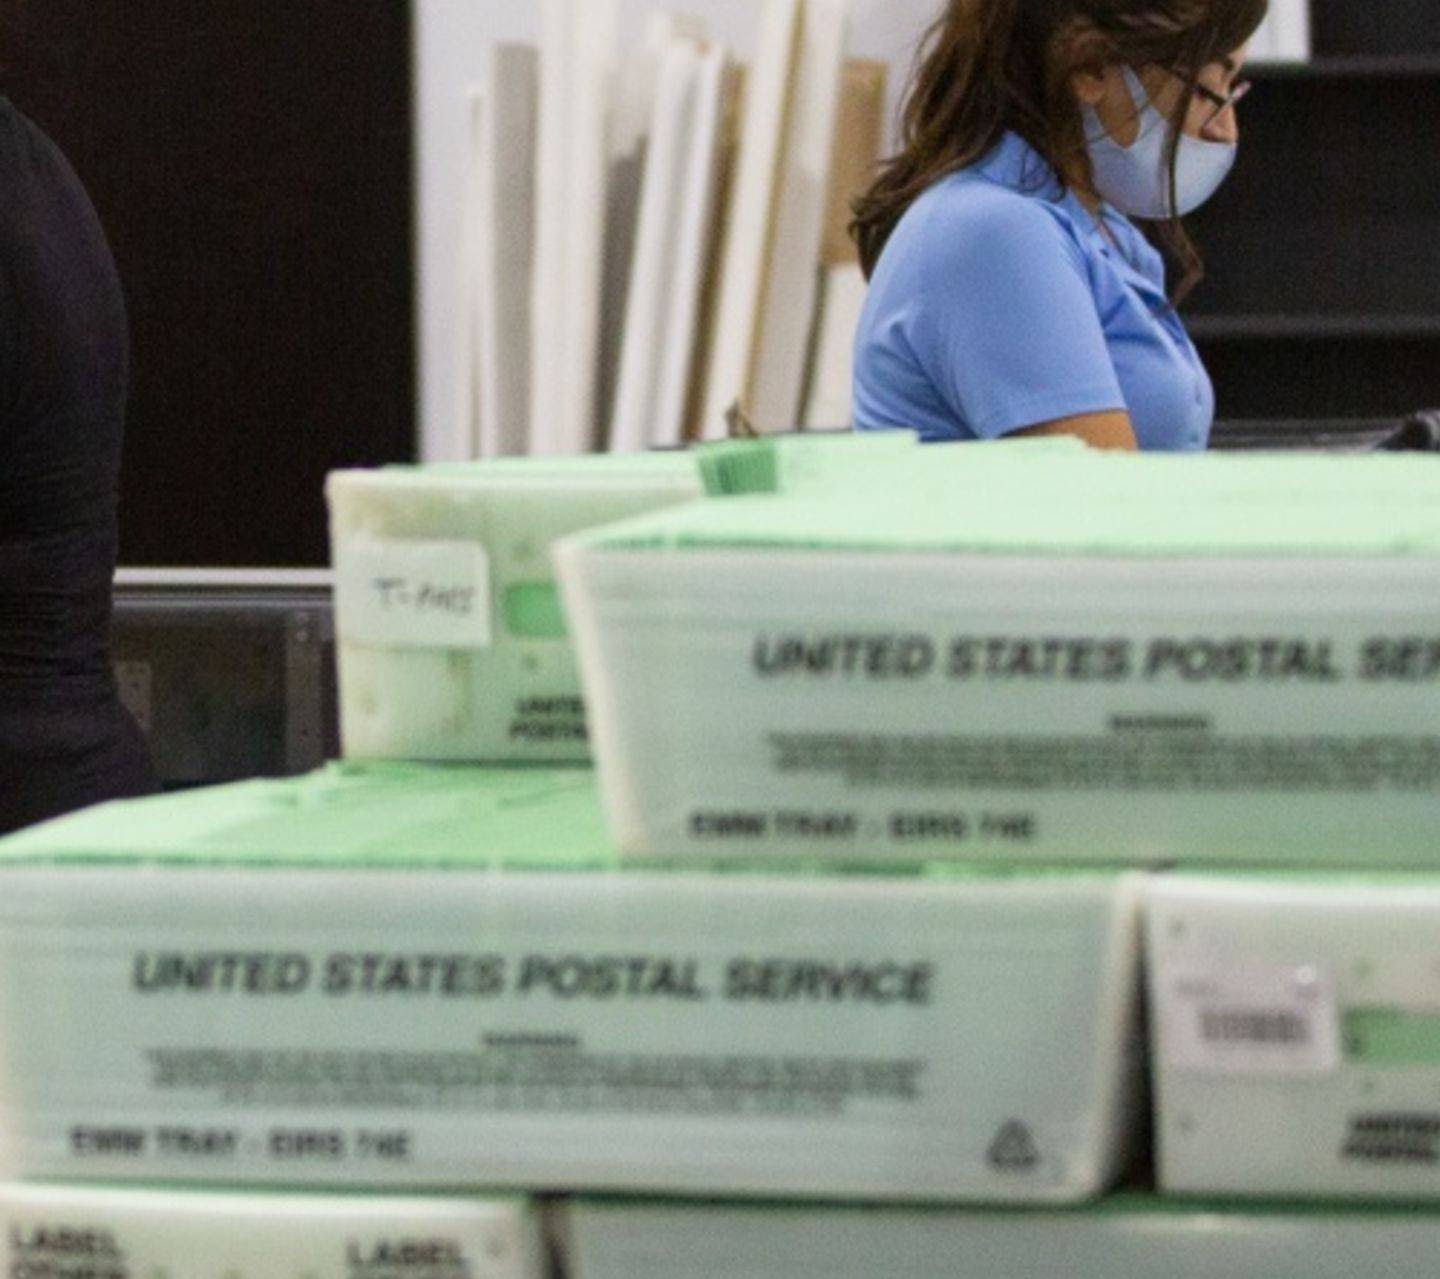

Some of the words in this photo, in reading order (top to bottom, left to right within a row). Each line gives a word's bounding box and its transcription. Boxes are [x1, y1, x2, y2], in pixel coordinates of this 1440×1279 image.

[754, 635, 931, 678] UNITED
[946, 637, 1122, 680] STATES
[1140, 637, 1343, 682] POSTAL
[132, 952, 310, 998] UNITED
[322, 956, 504, 1001] STATES
[517, 959, 708, 1004] POSTAL
[726, 961, 933, 1008] SERVICE
[11, 1227, 120, 1258] LABEL
[347, 1237, 465, 1268] LABEL
